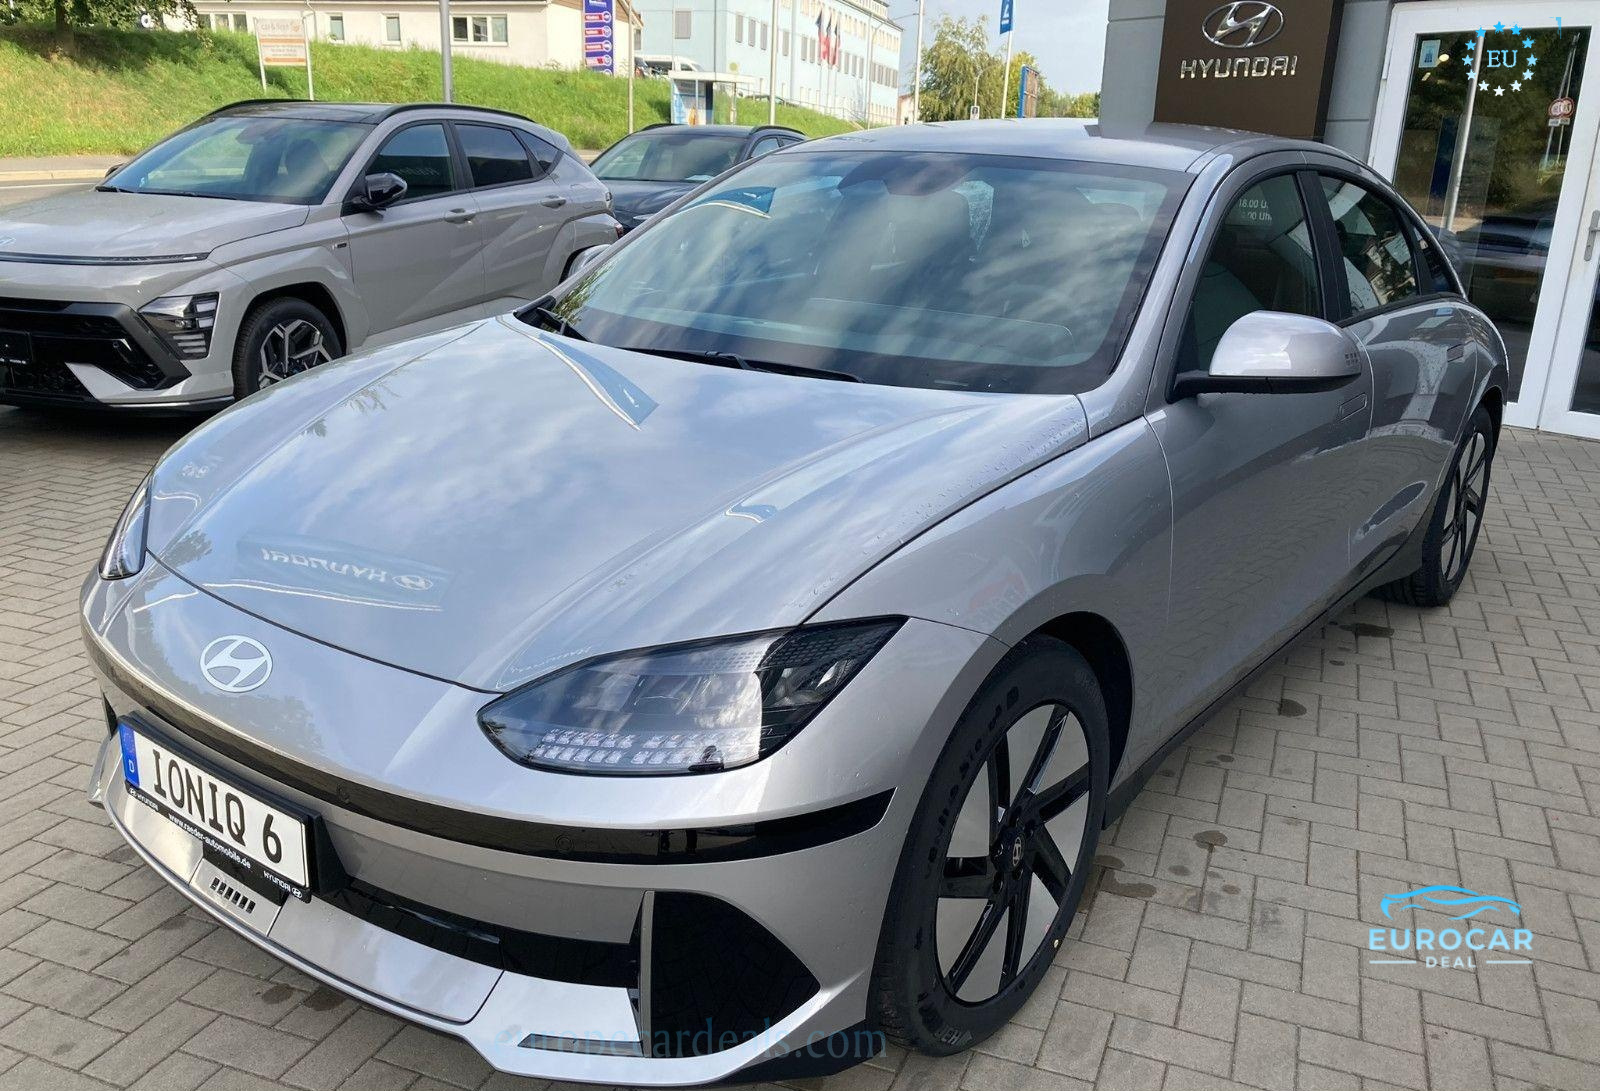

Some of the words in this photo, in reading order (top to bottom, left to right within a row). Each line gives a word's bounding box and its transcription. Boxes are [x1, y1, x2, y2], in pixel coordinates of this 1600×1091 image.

[1180, 55, 1298, 79] HYUNDAI
[128, 758, 135, 773] D
[152, 748, 246, 847] IONIQ
[262, 813, 283, 864] 6
[263, 870, 291, 892] HYUNDAI
